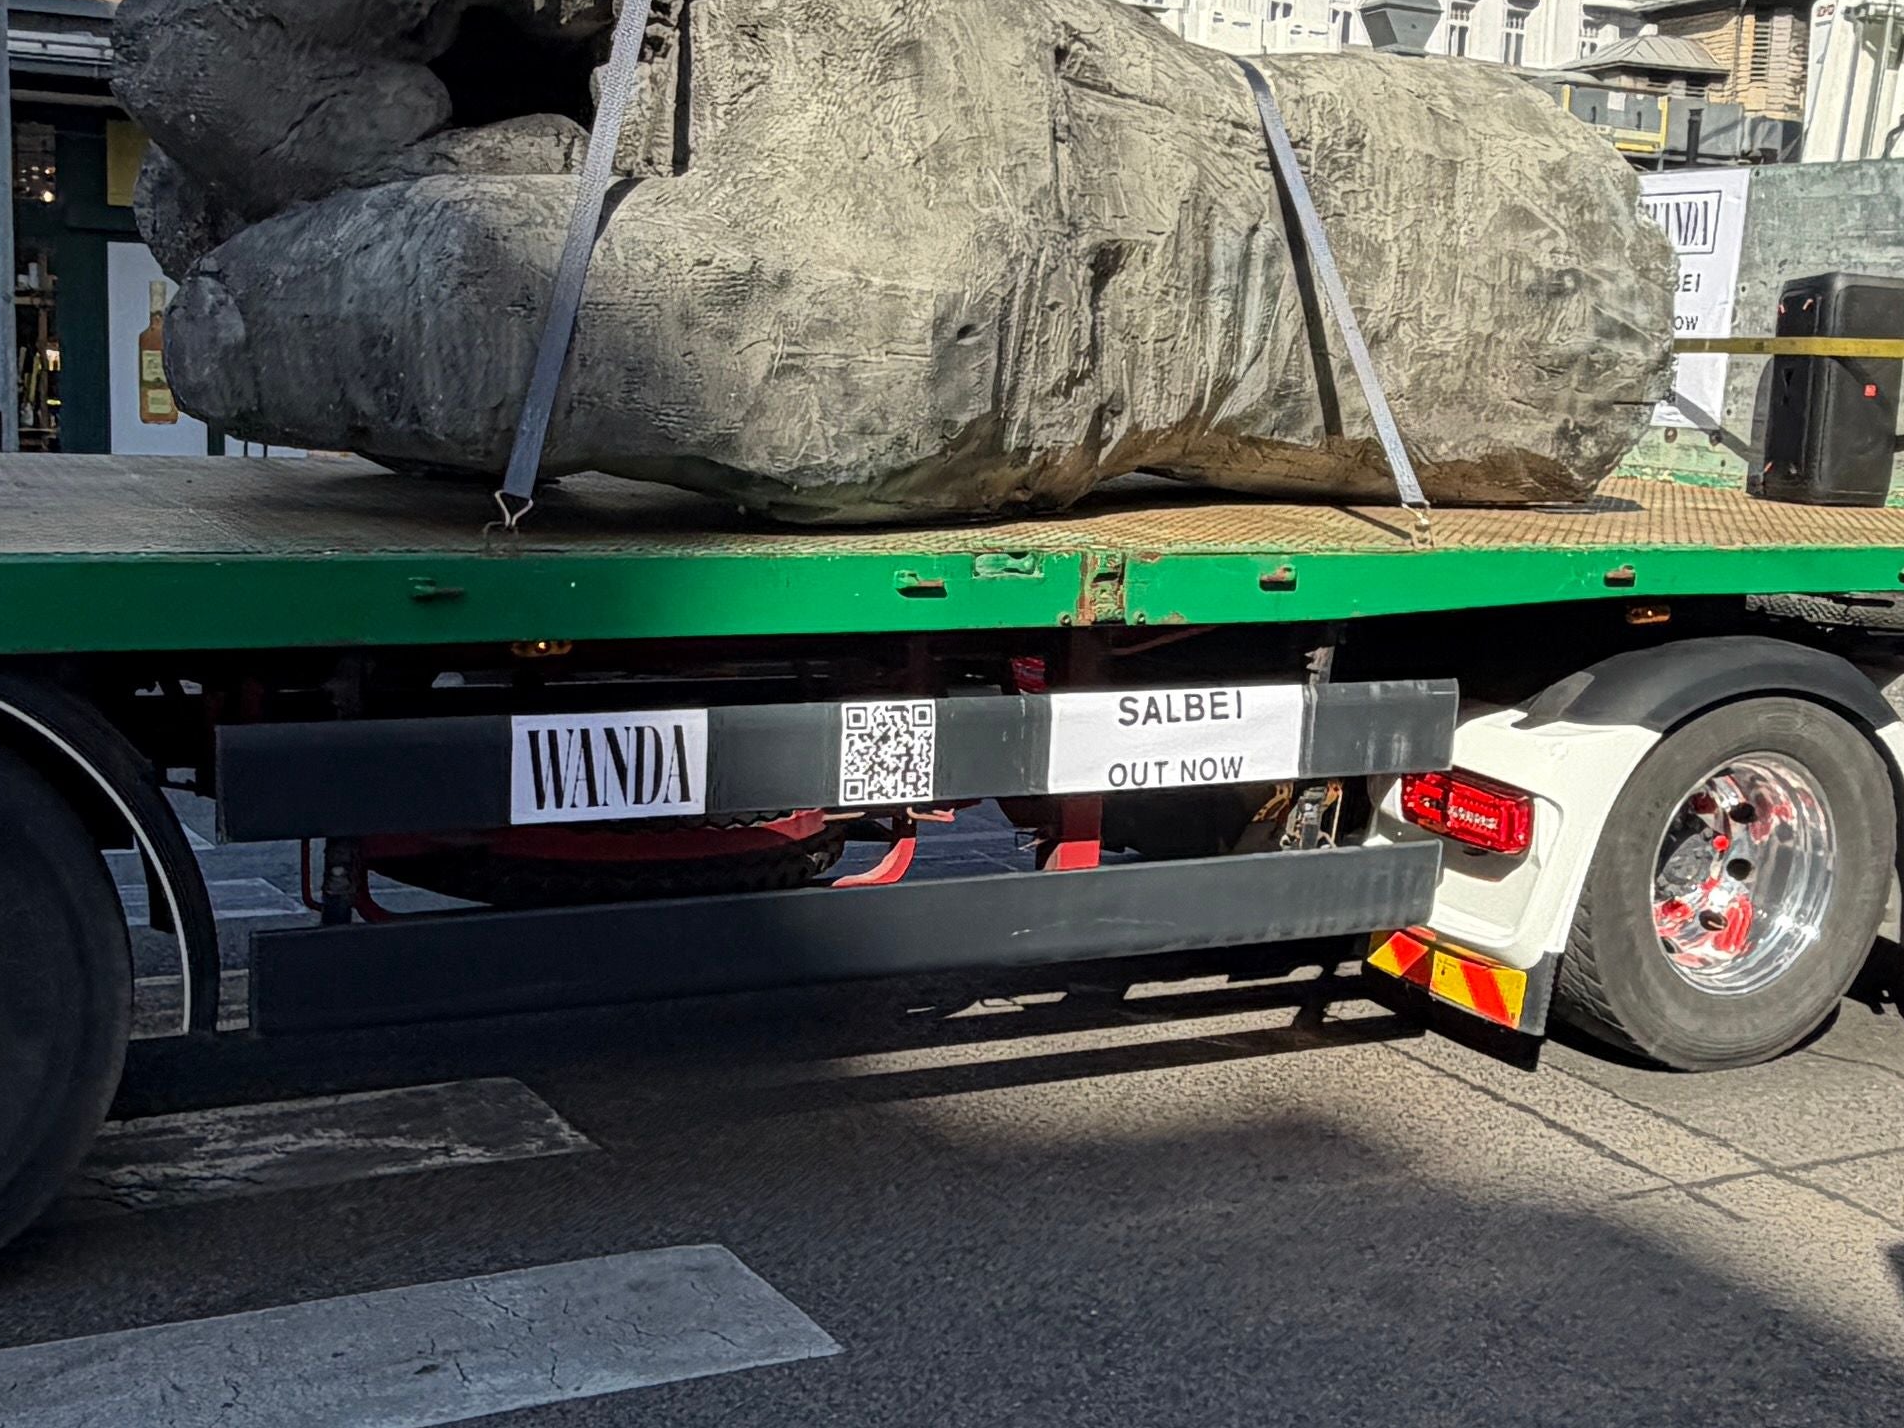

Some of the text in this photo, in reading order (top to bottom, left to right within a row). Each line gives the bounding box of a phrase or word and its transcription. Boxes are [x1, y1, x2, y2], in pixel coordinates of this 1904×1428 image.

[1674, 315, 1699, 331] OW
[1118, 690, 1242, 727] SALBEI
[527, 724, 692, 810] WANDA
[1108, 756, 1244, 788] OUT NOW
